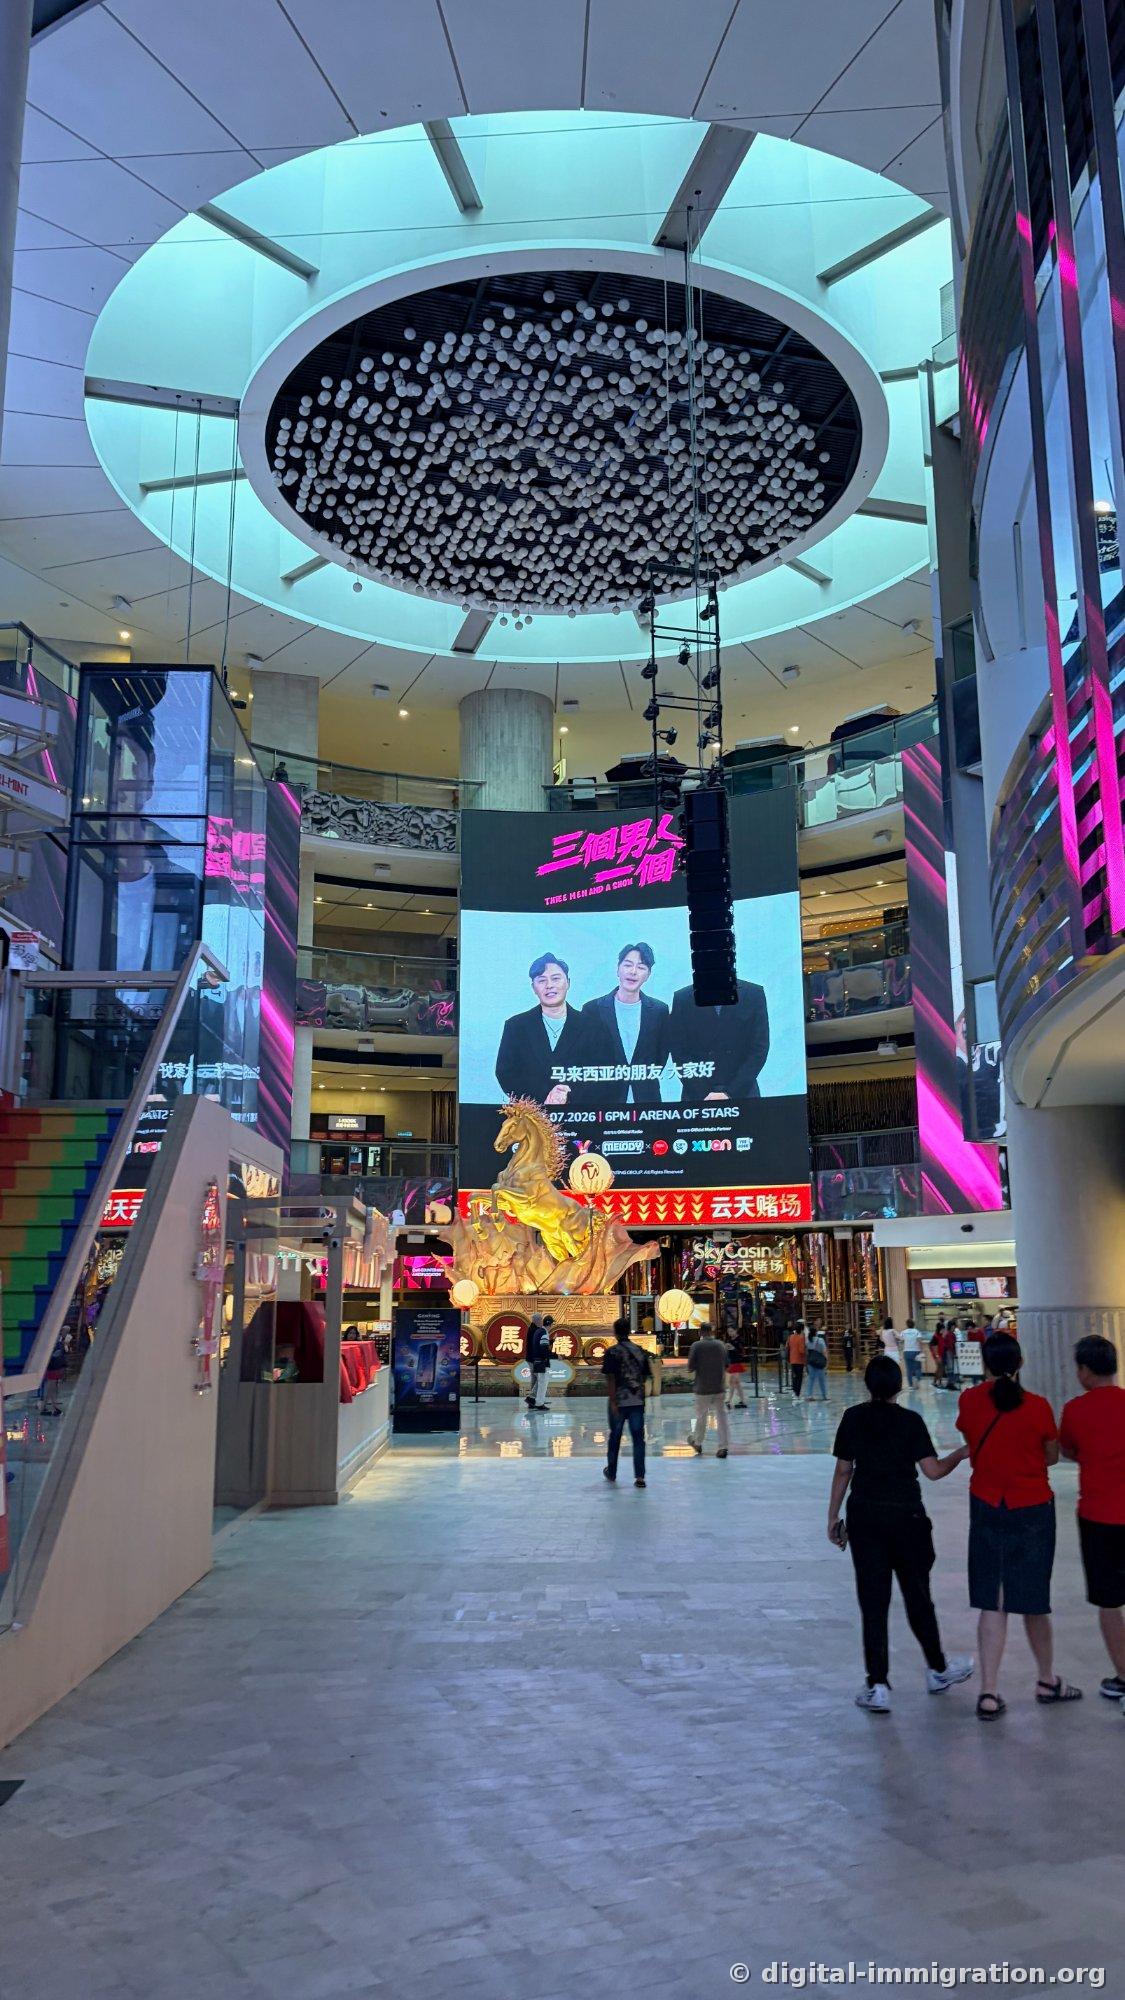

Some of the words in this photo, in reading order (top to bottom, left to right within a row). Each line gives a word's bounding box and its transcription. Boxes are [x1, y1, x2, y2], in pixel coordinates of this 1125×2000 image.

[536, 814, 687, 876] 三個男人
[592, 848, 677, 888] 一個
[544, 893, 568, 906] THREE
[569, 889, 588, 900] MEN
[588, 885, 604, 896] AND
[605, 883, 611, 892] A
[612, 878, 633, 890] SHOW
[551, 1063, 663, 1082] 马来西亚的朋友
[667, 1061, 716, 1079] 大家好
[604, 1110, 630, 1121] 6PM
[639, 1109, 681, 1121] ARENA
[683, 1108, 700, 1119] OF
[701, 1106, 740, 1119] STARS
[603, 1141, 642, 1152] MELODY
[710, 1193, 802, 1219] 云天赌场
[721, 1259, 784, 1275] 云天赌场
[495, 1325, 524, 1354] 馬
